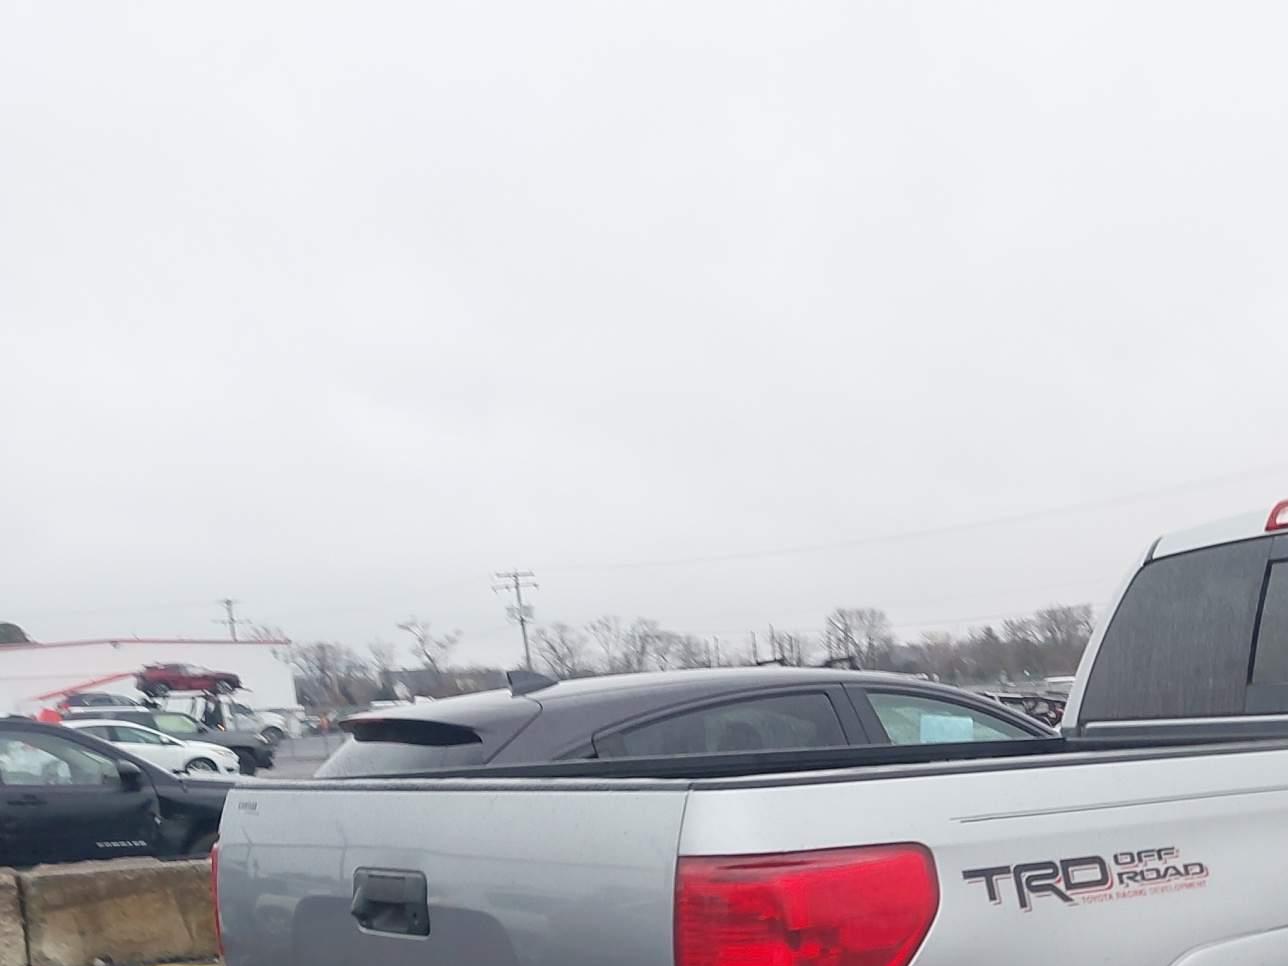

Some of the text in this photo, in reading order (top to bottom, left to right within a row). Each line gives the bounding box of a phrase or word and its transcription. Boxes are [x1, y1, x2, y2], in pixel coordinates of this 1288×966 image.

[1113, 847, 1180, 867] OFF
[962, 855, 1114, 912] TRD
[1117, 862, 1209, 887] ROAD
